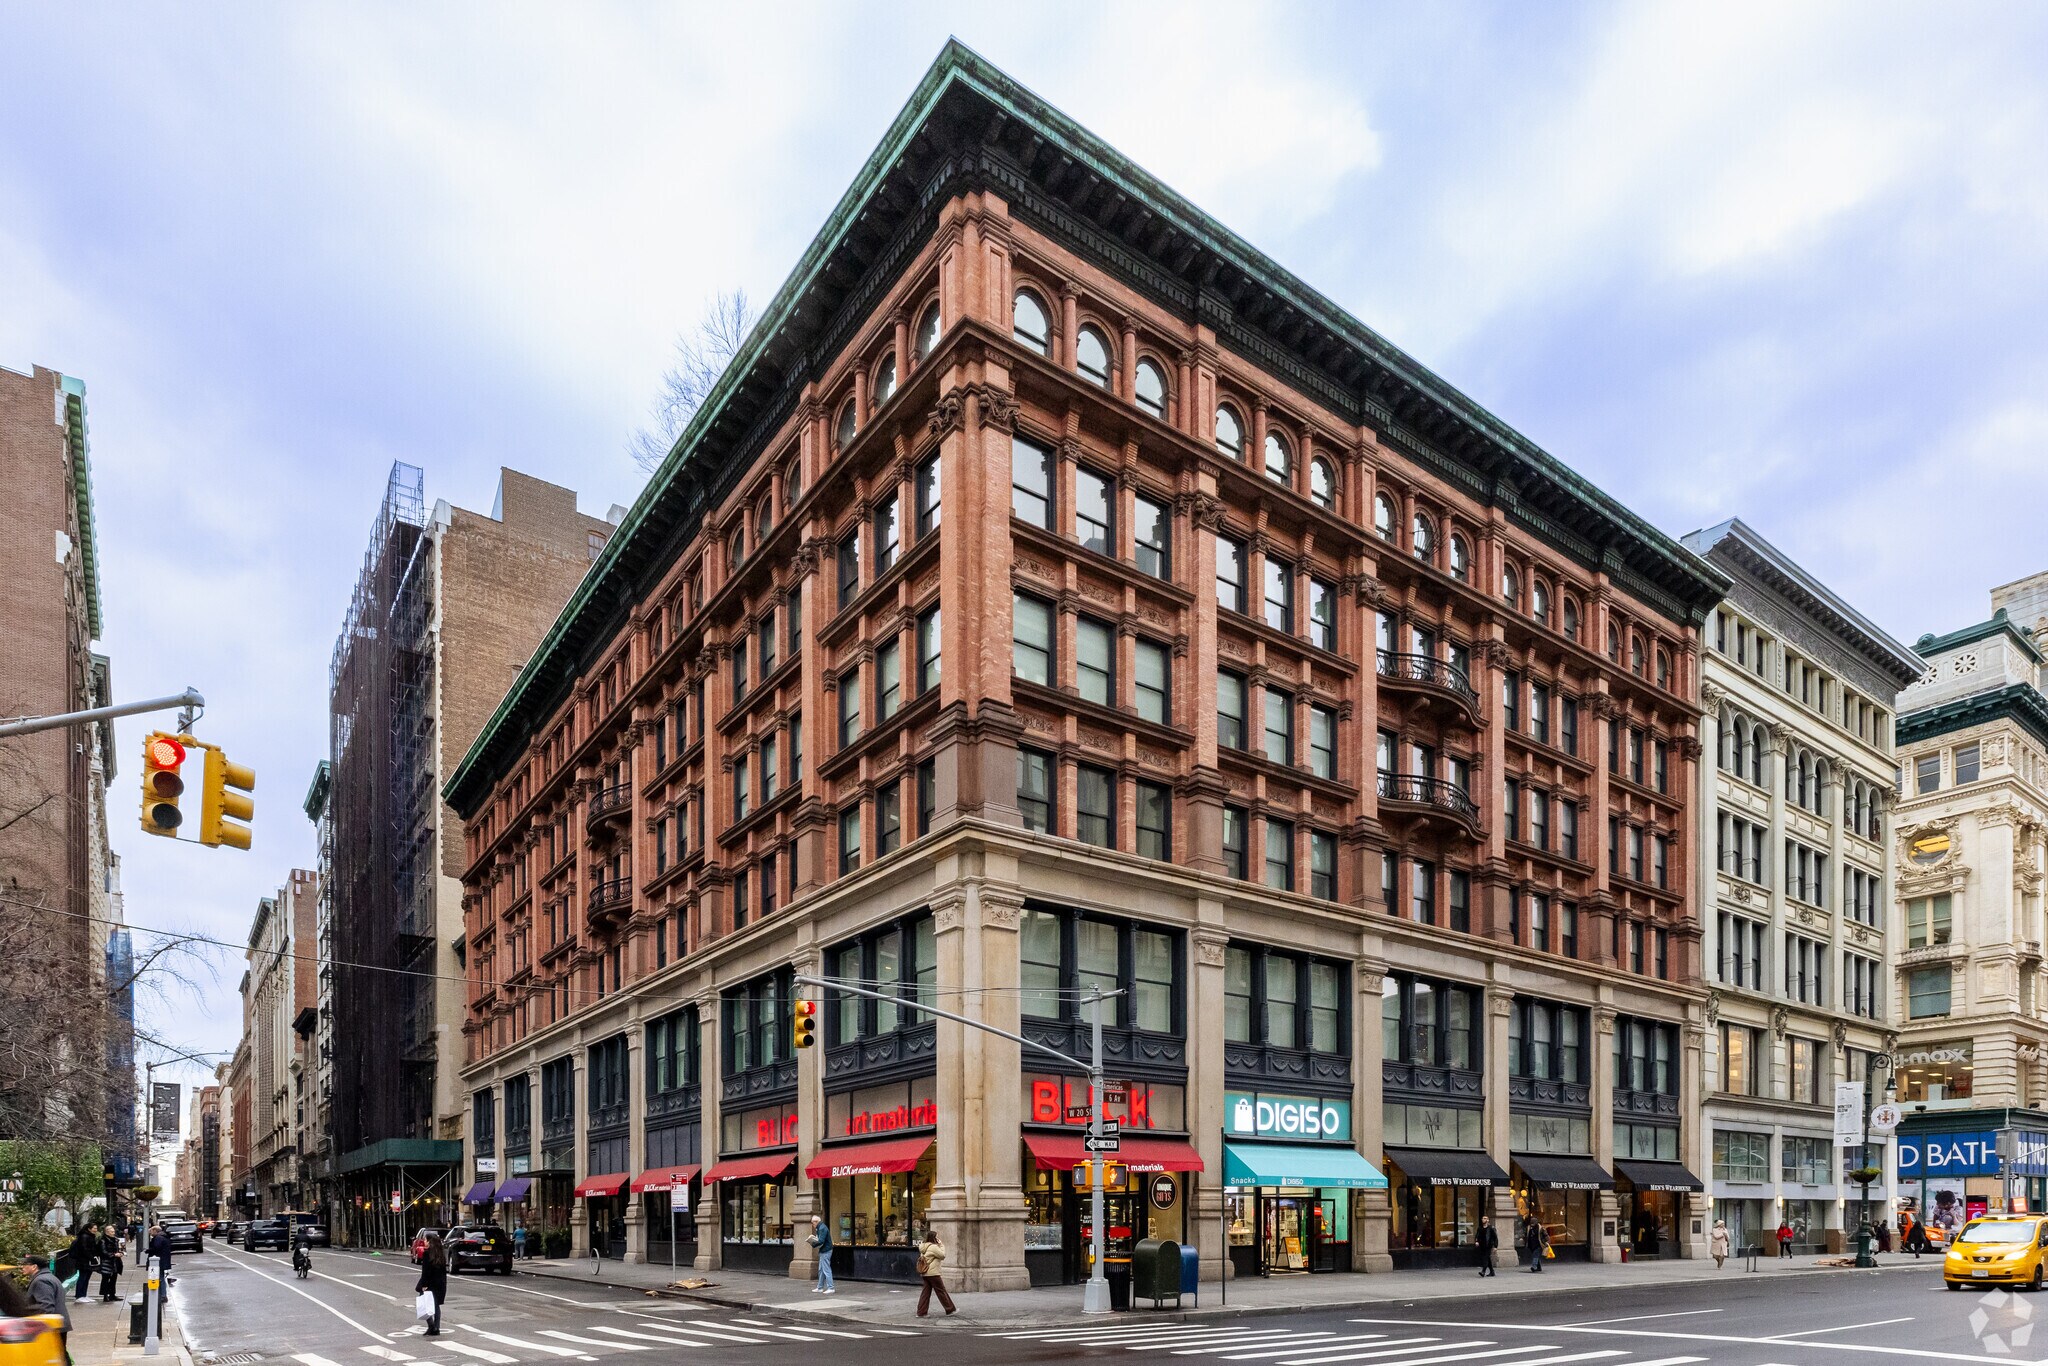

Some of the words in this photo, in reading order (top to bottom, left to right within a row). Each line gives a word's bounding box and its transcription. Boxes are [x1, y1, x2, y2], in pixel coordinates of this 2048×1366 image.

[1032, 1080, 1155, 1128] BLK
[1109, 1094, 1113, 1102] 6
[846, 1111, 868, 1135] art
[872, 1098, 937, 1132] materia
[1069, 1109, 1075, 1117] W
[1076, 1108, 1084, 1117] 20
[1256, 1101, 1339, 1135] DIGISO
[757, 1113, 798, 1147] BLIC
[1927, 1141, 2003, 1167] BATH
[832, 1165, 852, 1177] BLICK
[858, 1165, 881, 1174] materials
[1131, 1164, 1164, 1172] materials
[1431, 1177, 1452, 1185] MEN'S
[1453, 1177, 1491, 1186] WEARHOUSE
[1568, 1181, 1600, 1190] WEARHOUSE
